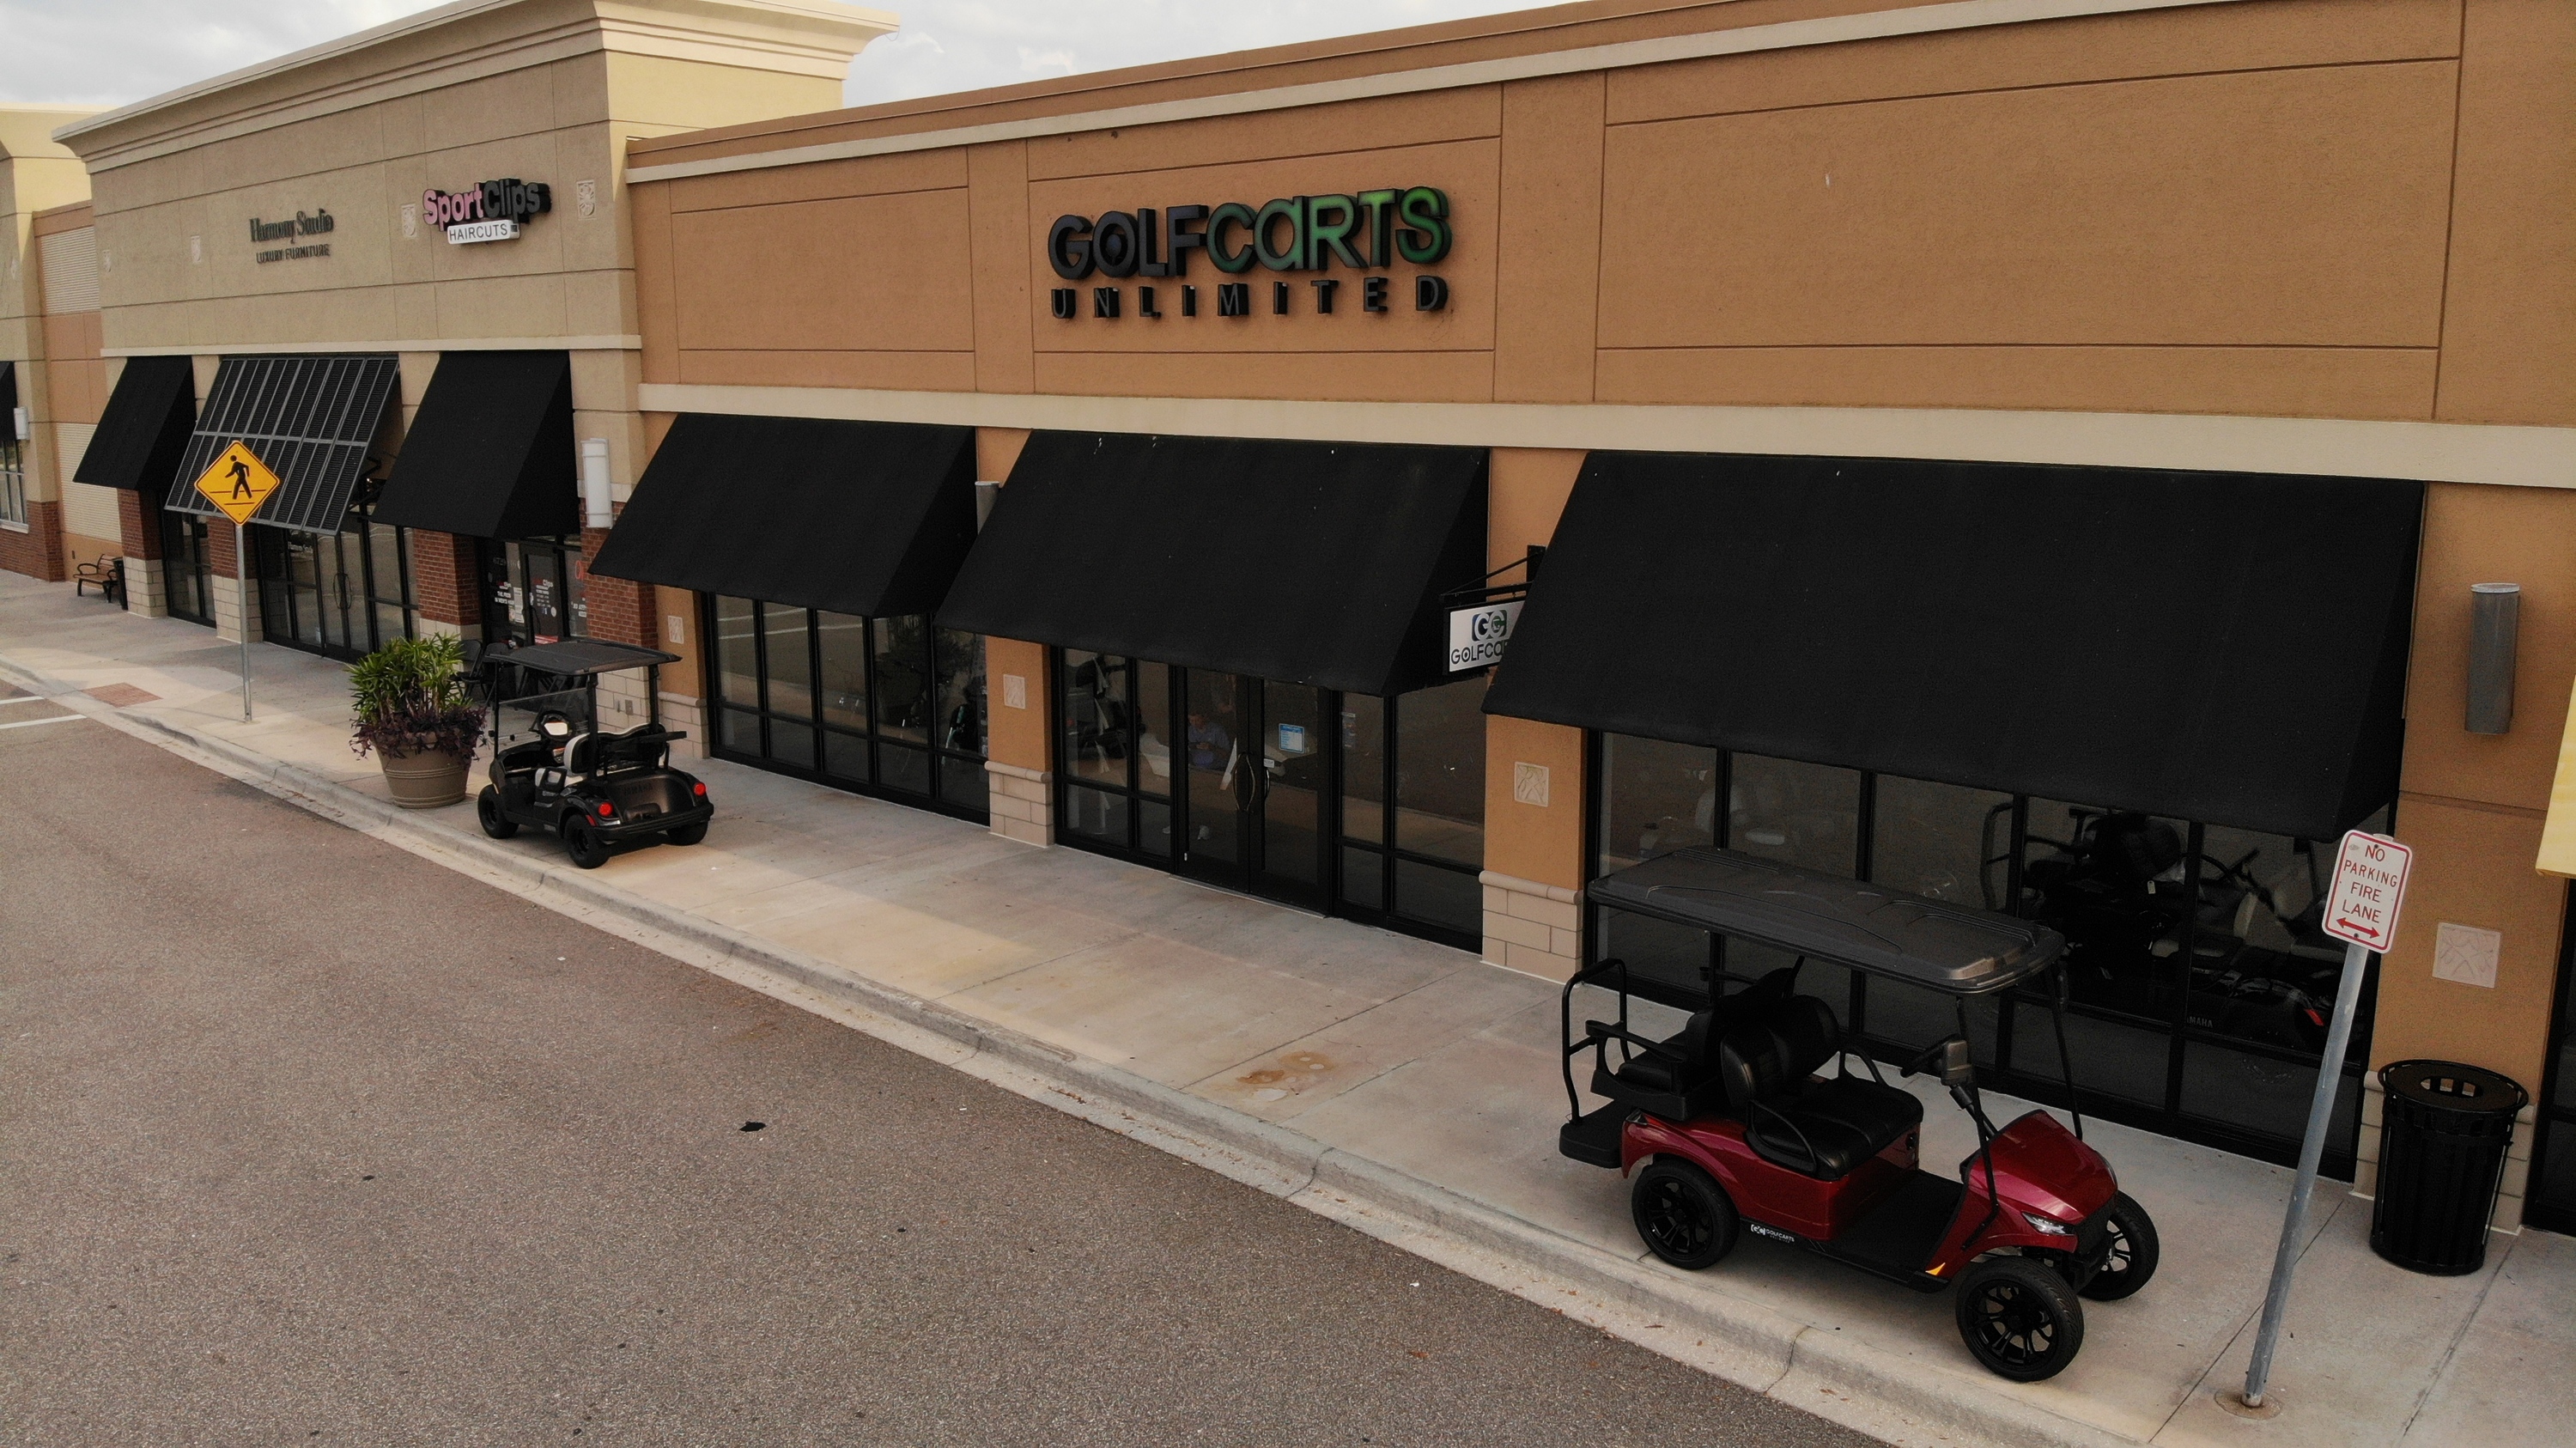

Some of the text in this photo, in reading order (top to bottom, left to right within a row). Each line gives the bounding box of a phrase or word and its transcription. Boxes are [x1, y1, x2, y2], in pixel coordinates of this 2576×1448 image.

[449, 223, 508, 241] HAIRCUTS
[256, 243, 331, 264] LUXURY FURNITURE
[1051, 276, 1448, 319] UNLIMITED
[2365, 845, 2385, 862] NO
[2343, 860, 2397, 888] PARKING
[2351, 881, 2382, 903] FIRE
[2342, 899, 2381, 923] LANE
